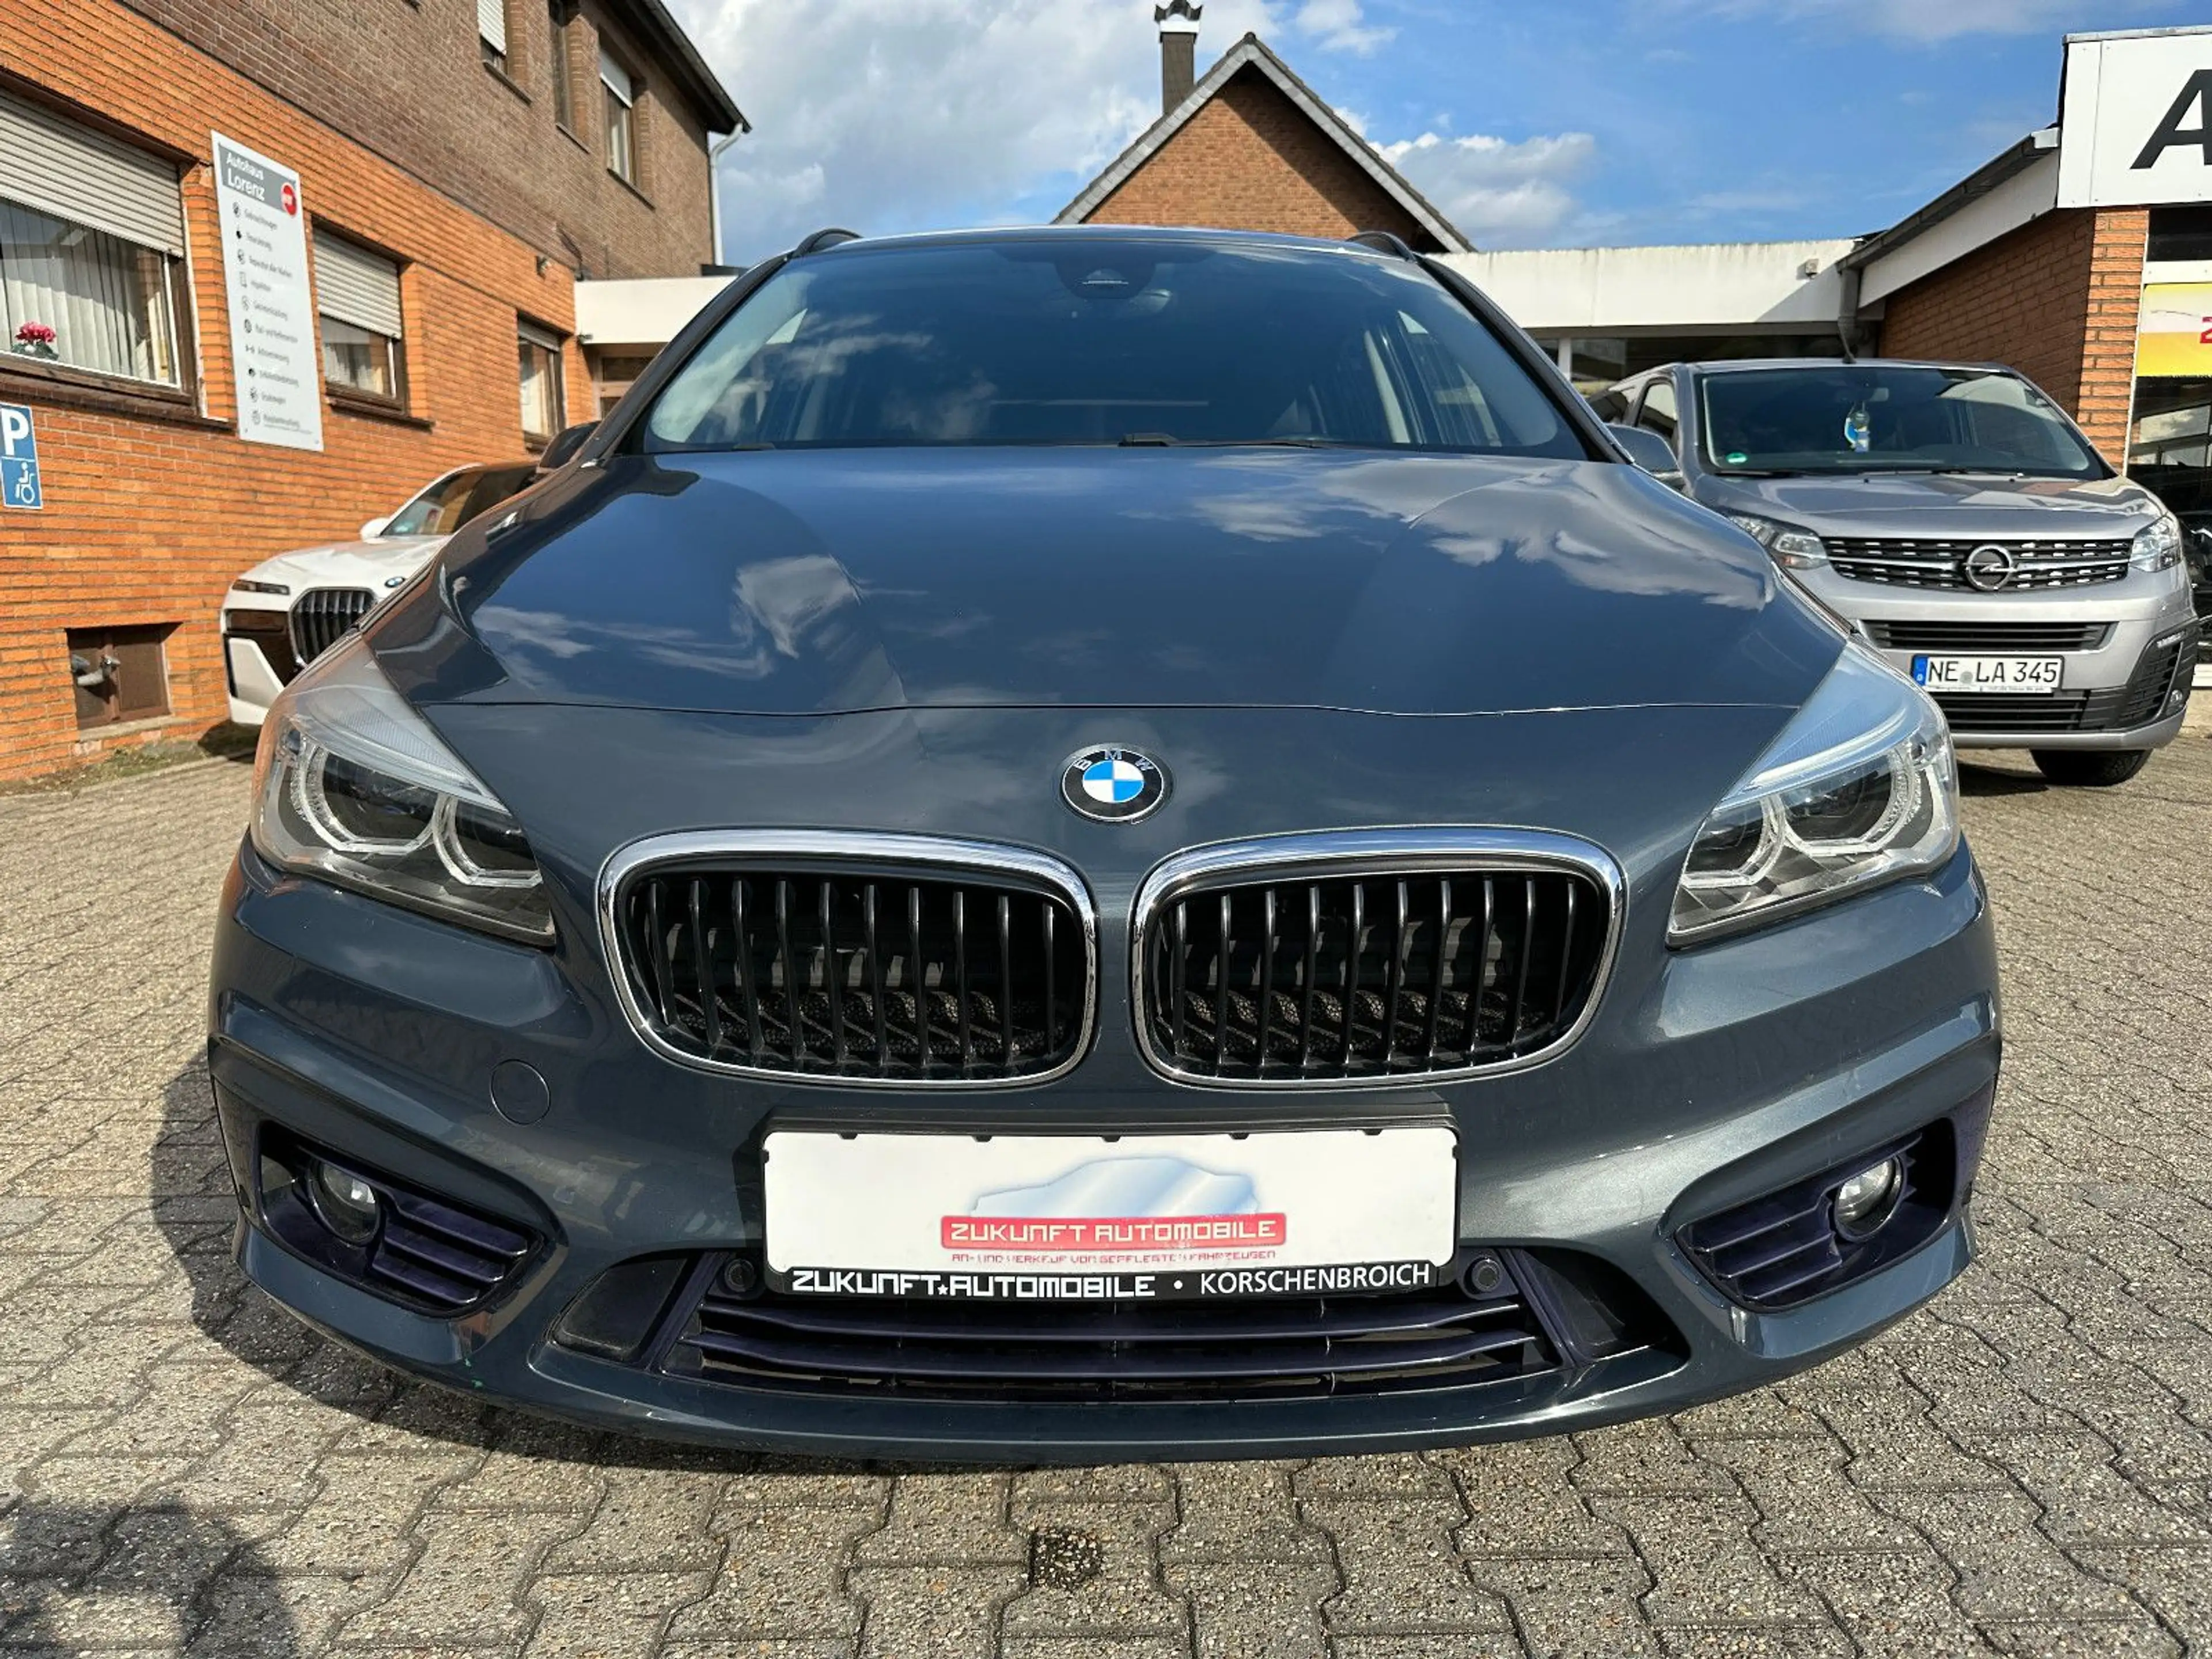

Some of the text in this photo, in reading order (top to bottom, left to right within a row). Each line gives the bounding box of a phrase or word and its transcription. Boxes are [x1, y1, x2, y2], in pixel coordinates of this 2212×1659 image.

[228, 168, 265, 201] Lorenz
[1, 407, 29, 456] P
[1929, 661, 2058, 683] NE LA 345
[1072, 749, 1154, 772] BMW
[950, 1221, 1277, 1243] ZUKUNFT AUTOMOBILE
[792, 1263, 1430, 1298] ZUKUNFT AUTOMOBILE KORSCHENBROICH
